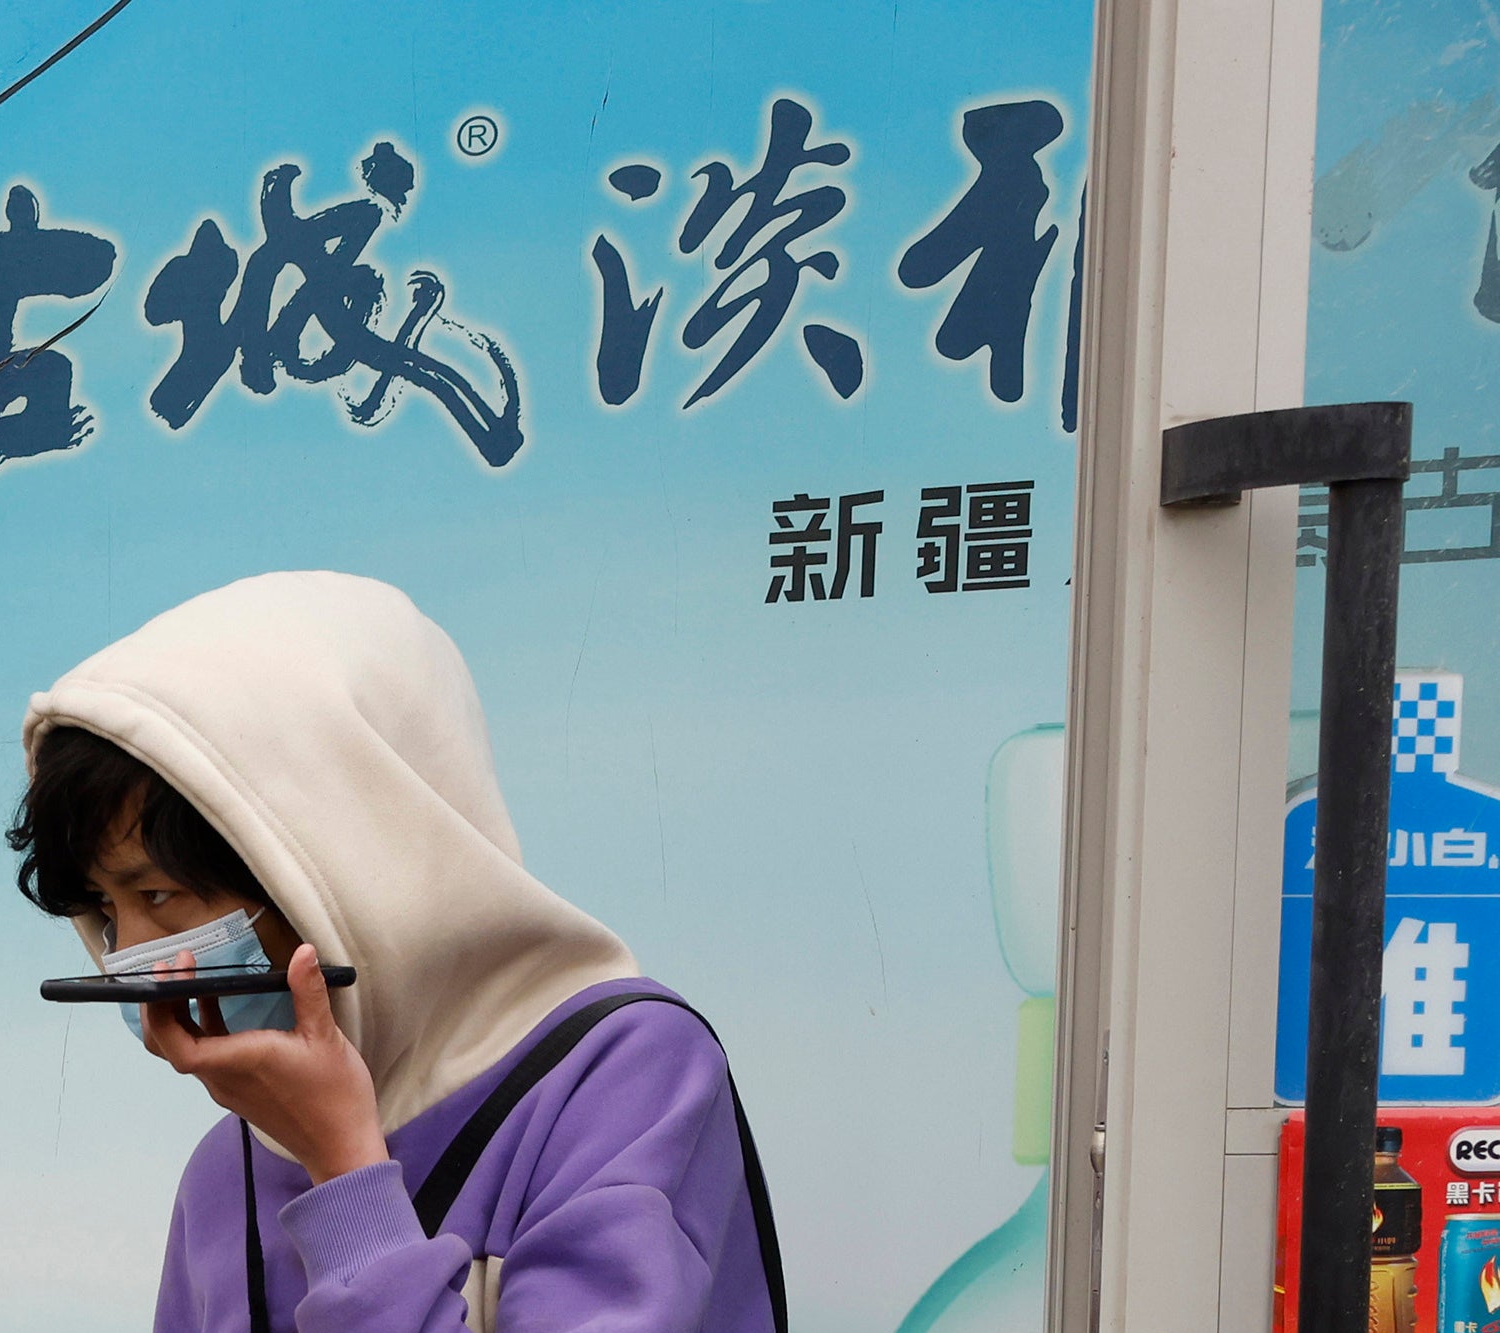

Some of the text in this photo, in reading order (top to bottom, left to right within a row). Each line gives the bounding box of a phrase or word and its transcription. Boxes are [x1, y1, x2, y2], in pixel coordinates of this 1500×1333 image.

[762, 479, 1036, 605] 新疆
[1305, 827, 1488, 870] 小白
[1446, 1182, 1500, 1205] 黑卡
